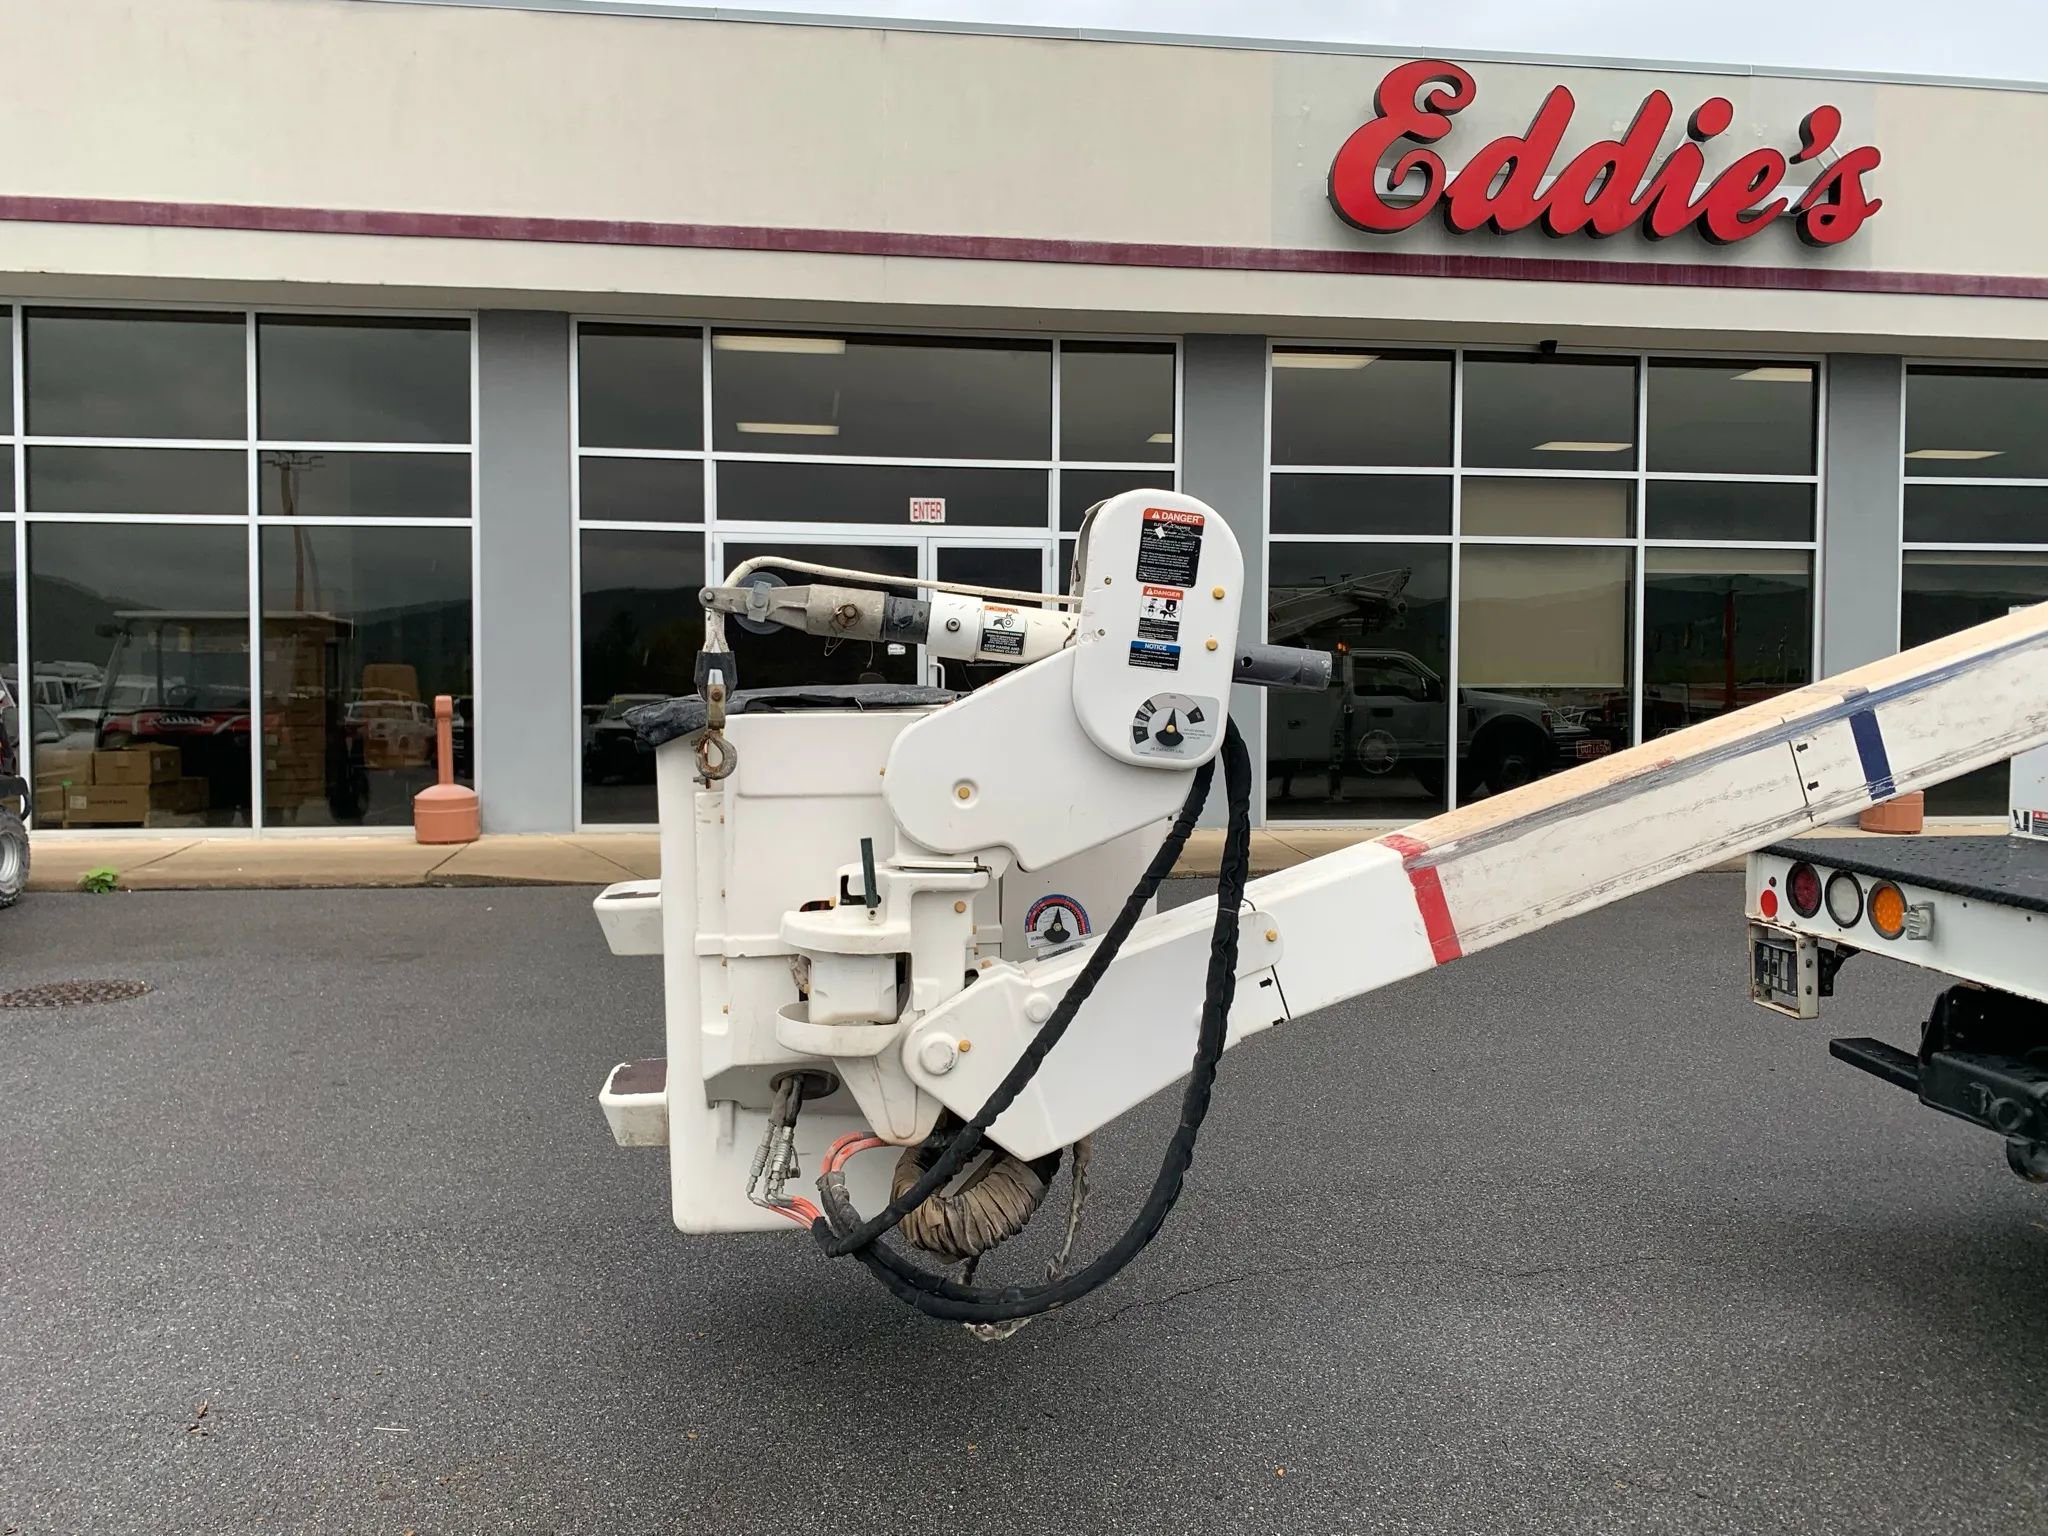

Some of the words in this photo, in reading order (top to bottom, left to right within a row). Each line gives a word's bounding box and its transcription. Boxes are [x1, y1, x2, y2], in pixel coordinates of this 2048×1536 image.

[1328, 59, 1882, 247] Eddie's
[912, 501, 942, 520] ENTER
[1161, 512, 1200, 524] DANGER
[1153, 589, 1181, 598] DANGER
[1144, 643, 1167, 651] NOTICE
